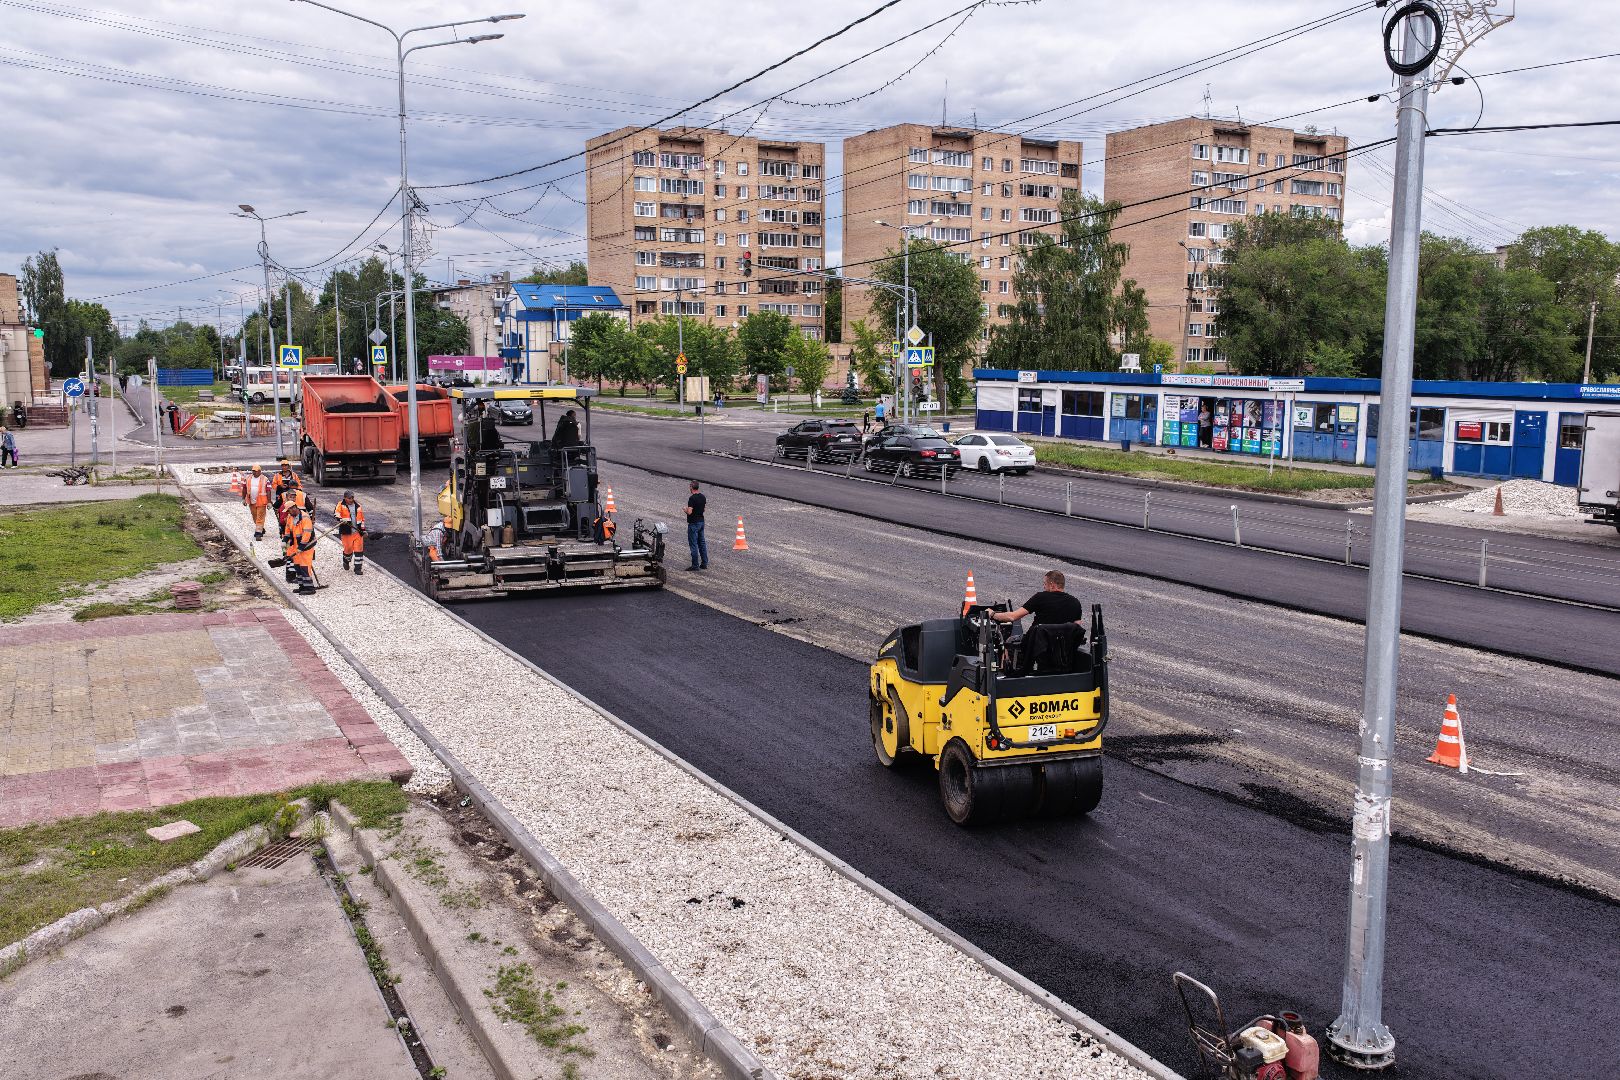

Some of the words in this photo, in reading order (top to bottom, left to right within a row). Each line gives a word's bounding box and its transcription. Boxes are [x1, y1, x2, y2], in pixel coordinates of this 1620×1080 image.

[1213, 378, 1268, 387] КОМИССИОННЫЙ
[1029, 698, 1079, 714] BOMAG
[1032, 726, 1054, 737] 2124
